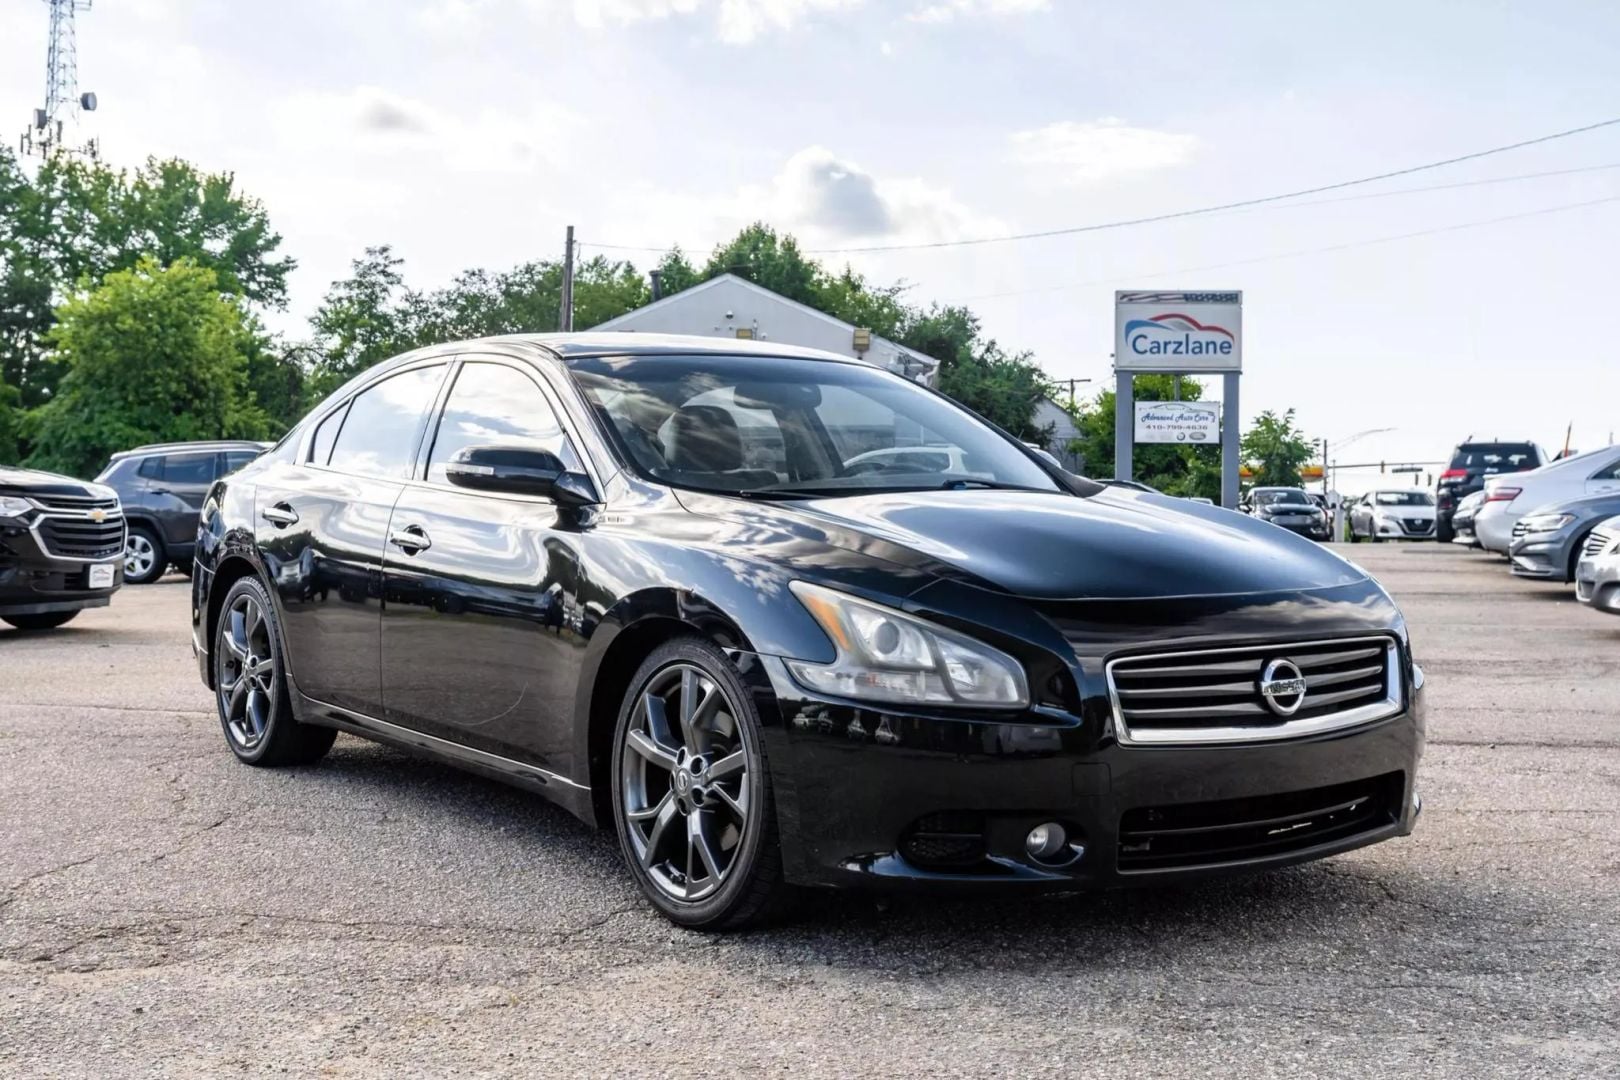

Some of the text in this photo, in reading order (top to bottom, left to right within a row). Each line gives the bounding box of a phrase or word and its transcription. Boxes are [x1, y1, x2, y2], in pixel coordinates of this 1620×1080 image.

[1132, 333, 1232, 355] Carzlane
[1141, 412, 1174, 422] Advanced
[1175, 412, 1193, 422] Auto
